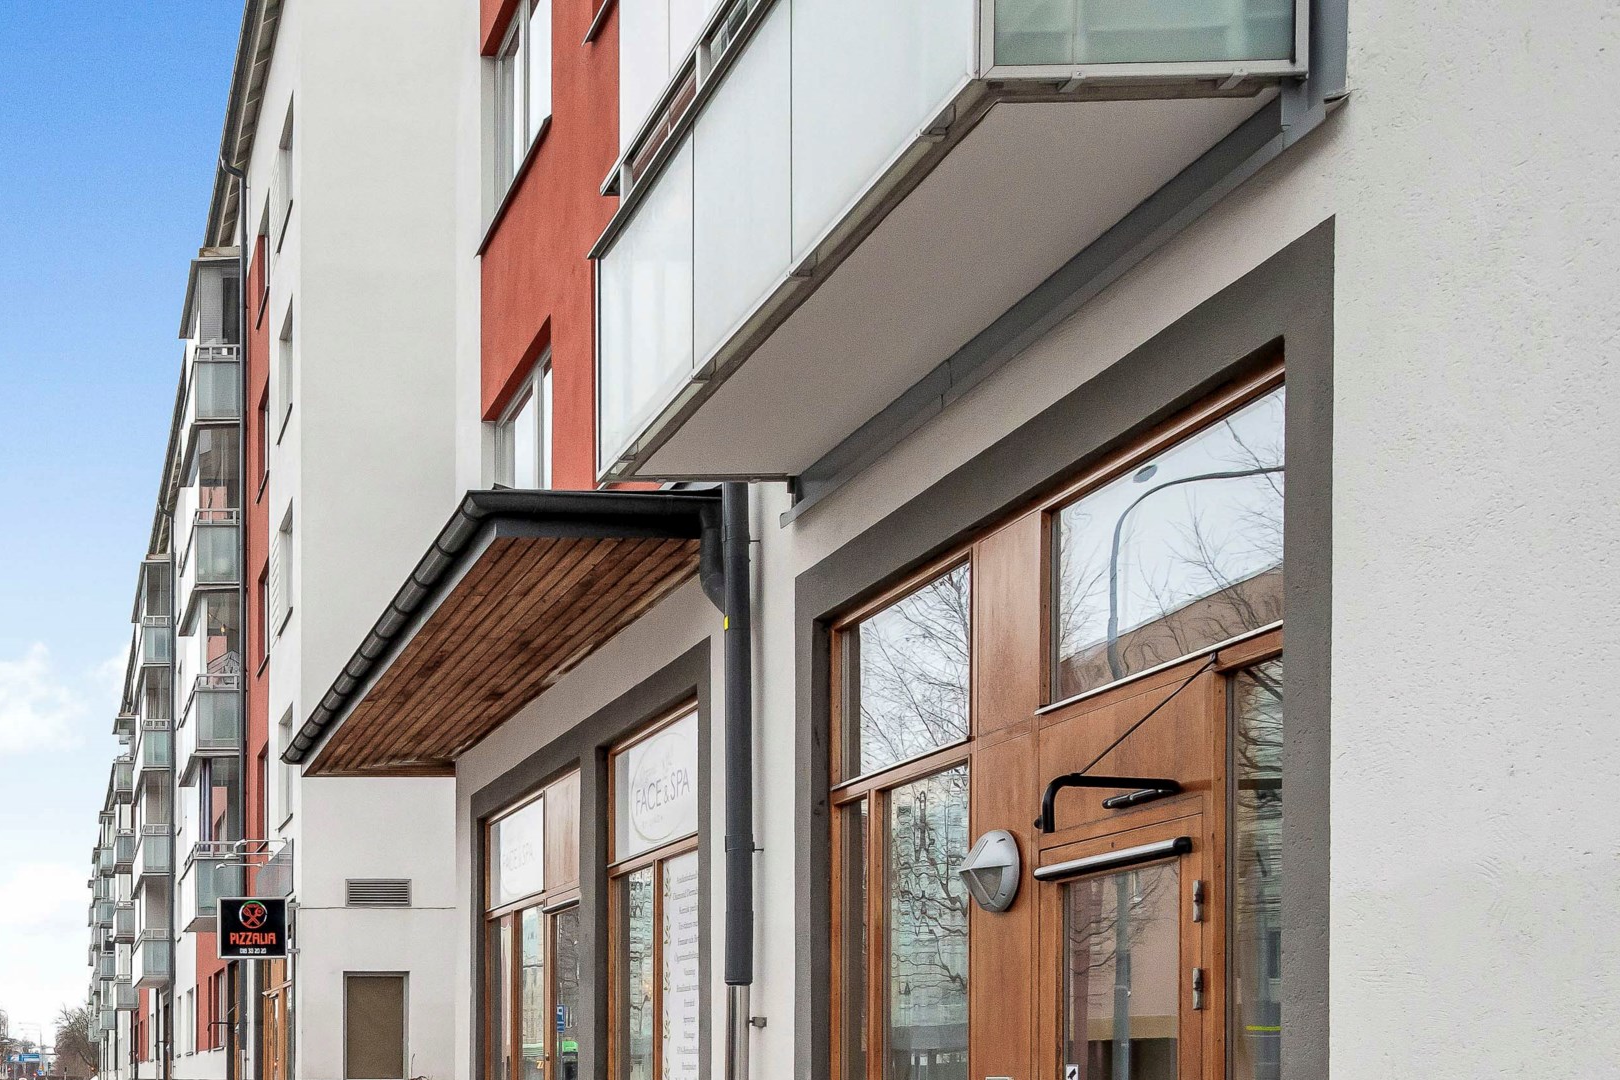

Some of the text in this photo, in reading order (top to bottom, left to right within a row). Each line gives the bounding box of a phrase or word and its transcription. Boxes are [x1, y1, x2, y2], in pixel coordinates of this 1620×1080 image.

[635, 778, 662, 816] FACE
[670, 767, 690, 801] SPA
[229, 931, 276, 945] PIZZALIA
